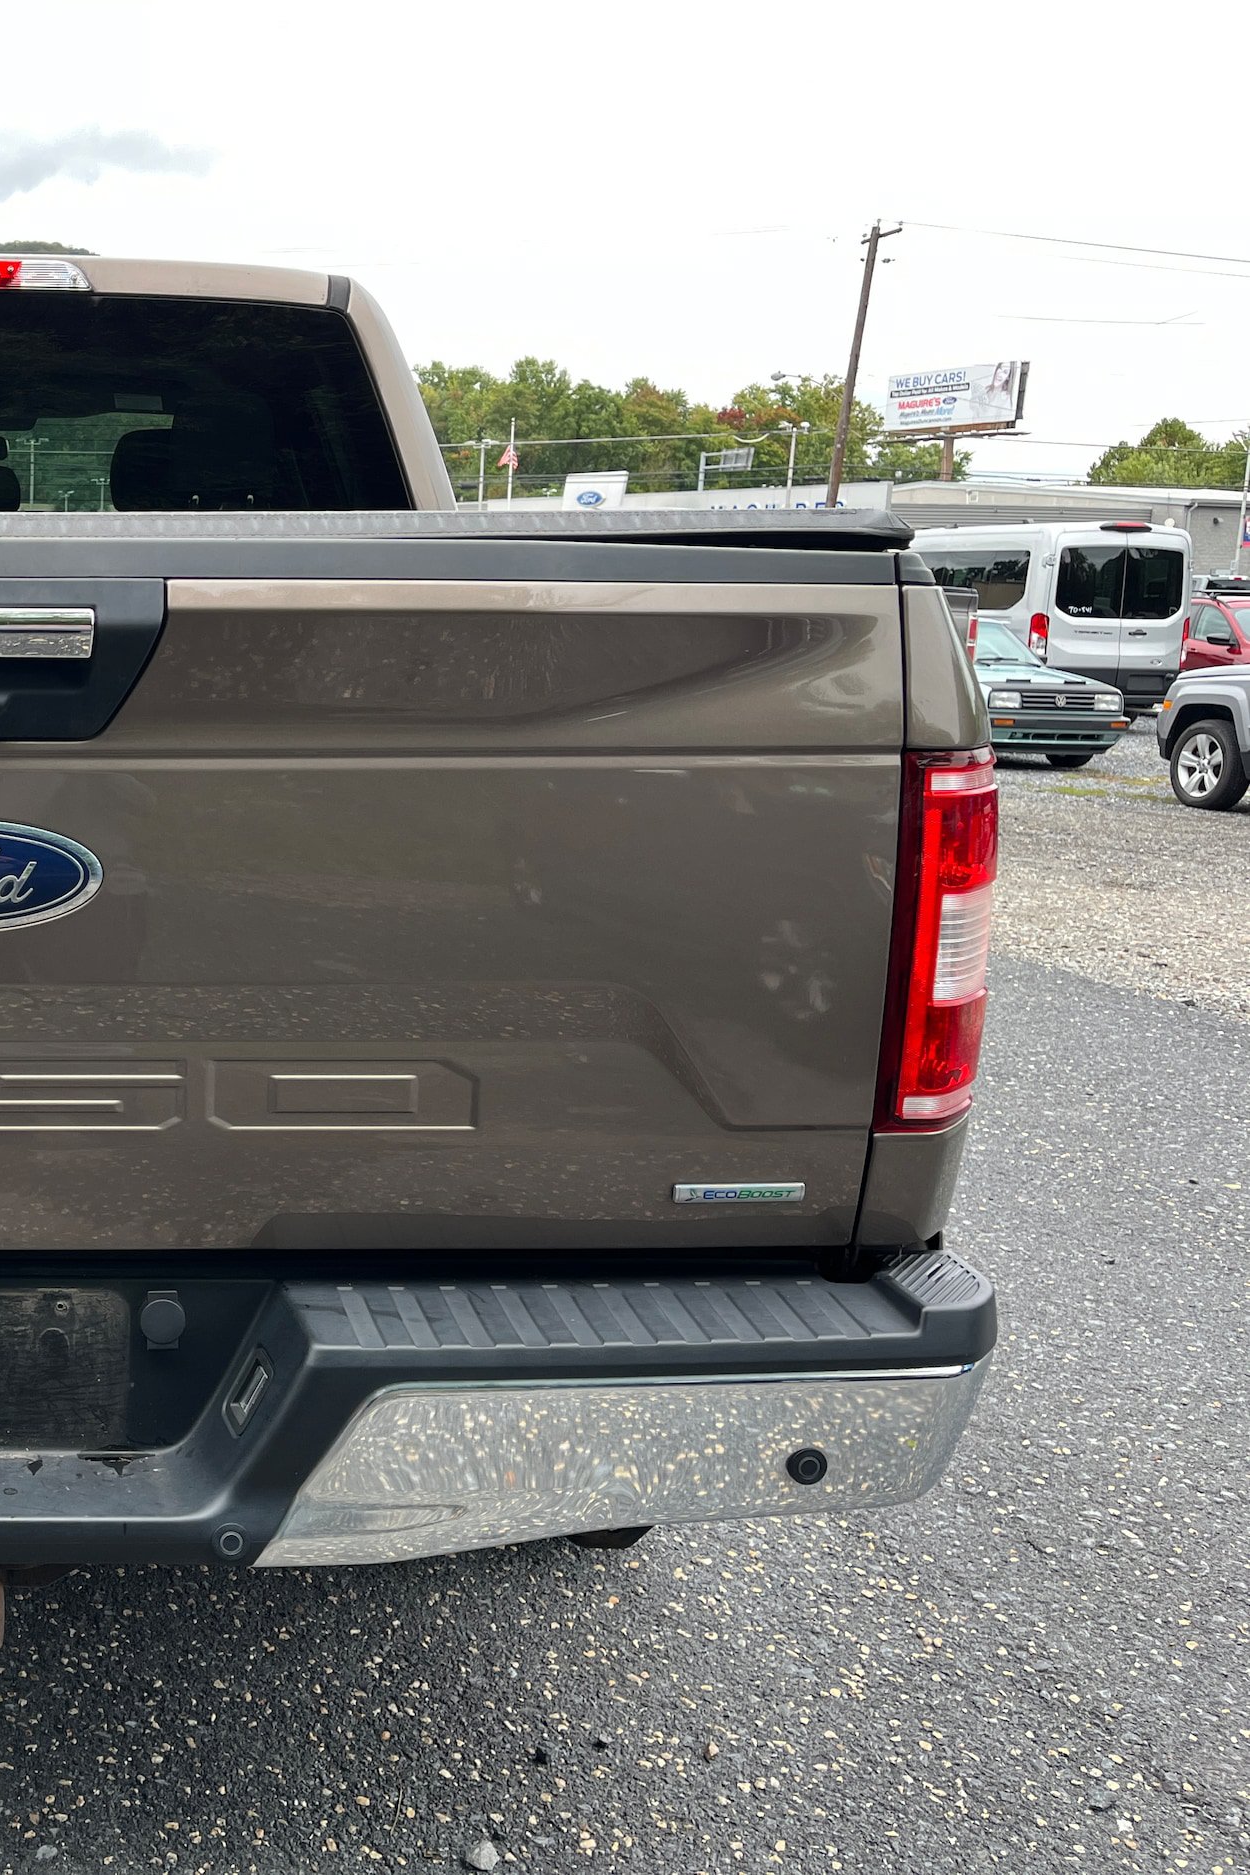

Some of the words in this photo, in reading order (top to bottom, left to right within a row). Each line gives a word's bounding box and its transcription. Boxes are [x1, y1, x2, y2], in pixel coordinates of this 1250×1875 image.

[895, 378, 910, 389] WE
[913, 375, 933, 387] BUY
[935, 371, 966, 384] CARS!
[898, 397, 941, 409] MAGUIRE'S
